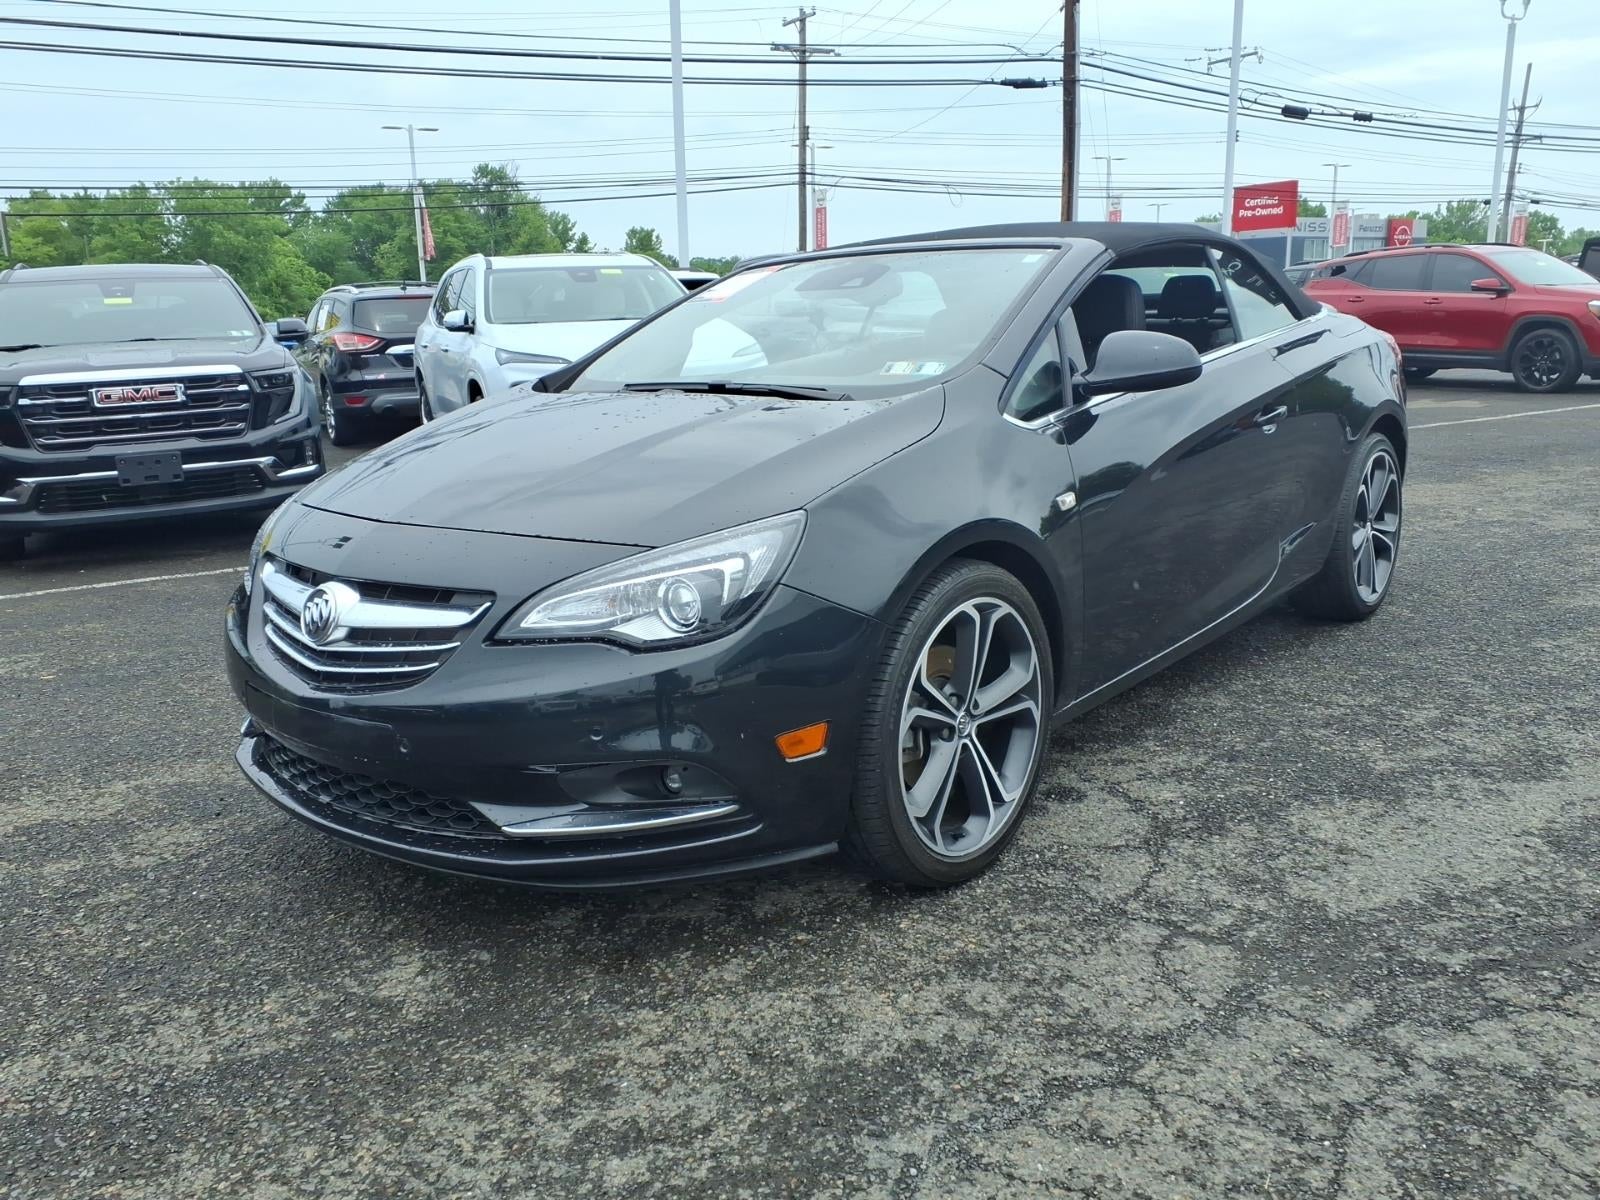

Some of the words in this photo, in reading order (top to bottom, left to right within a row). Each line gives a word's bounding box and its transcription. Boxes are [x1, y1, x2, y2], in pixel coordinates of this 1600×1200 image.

[1244, 196, 1279, 207] Certified
[1238, 205, 1284, 218] Pre-Owned
[98, 386, 178, 404] GMC
